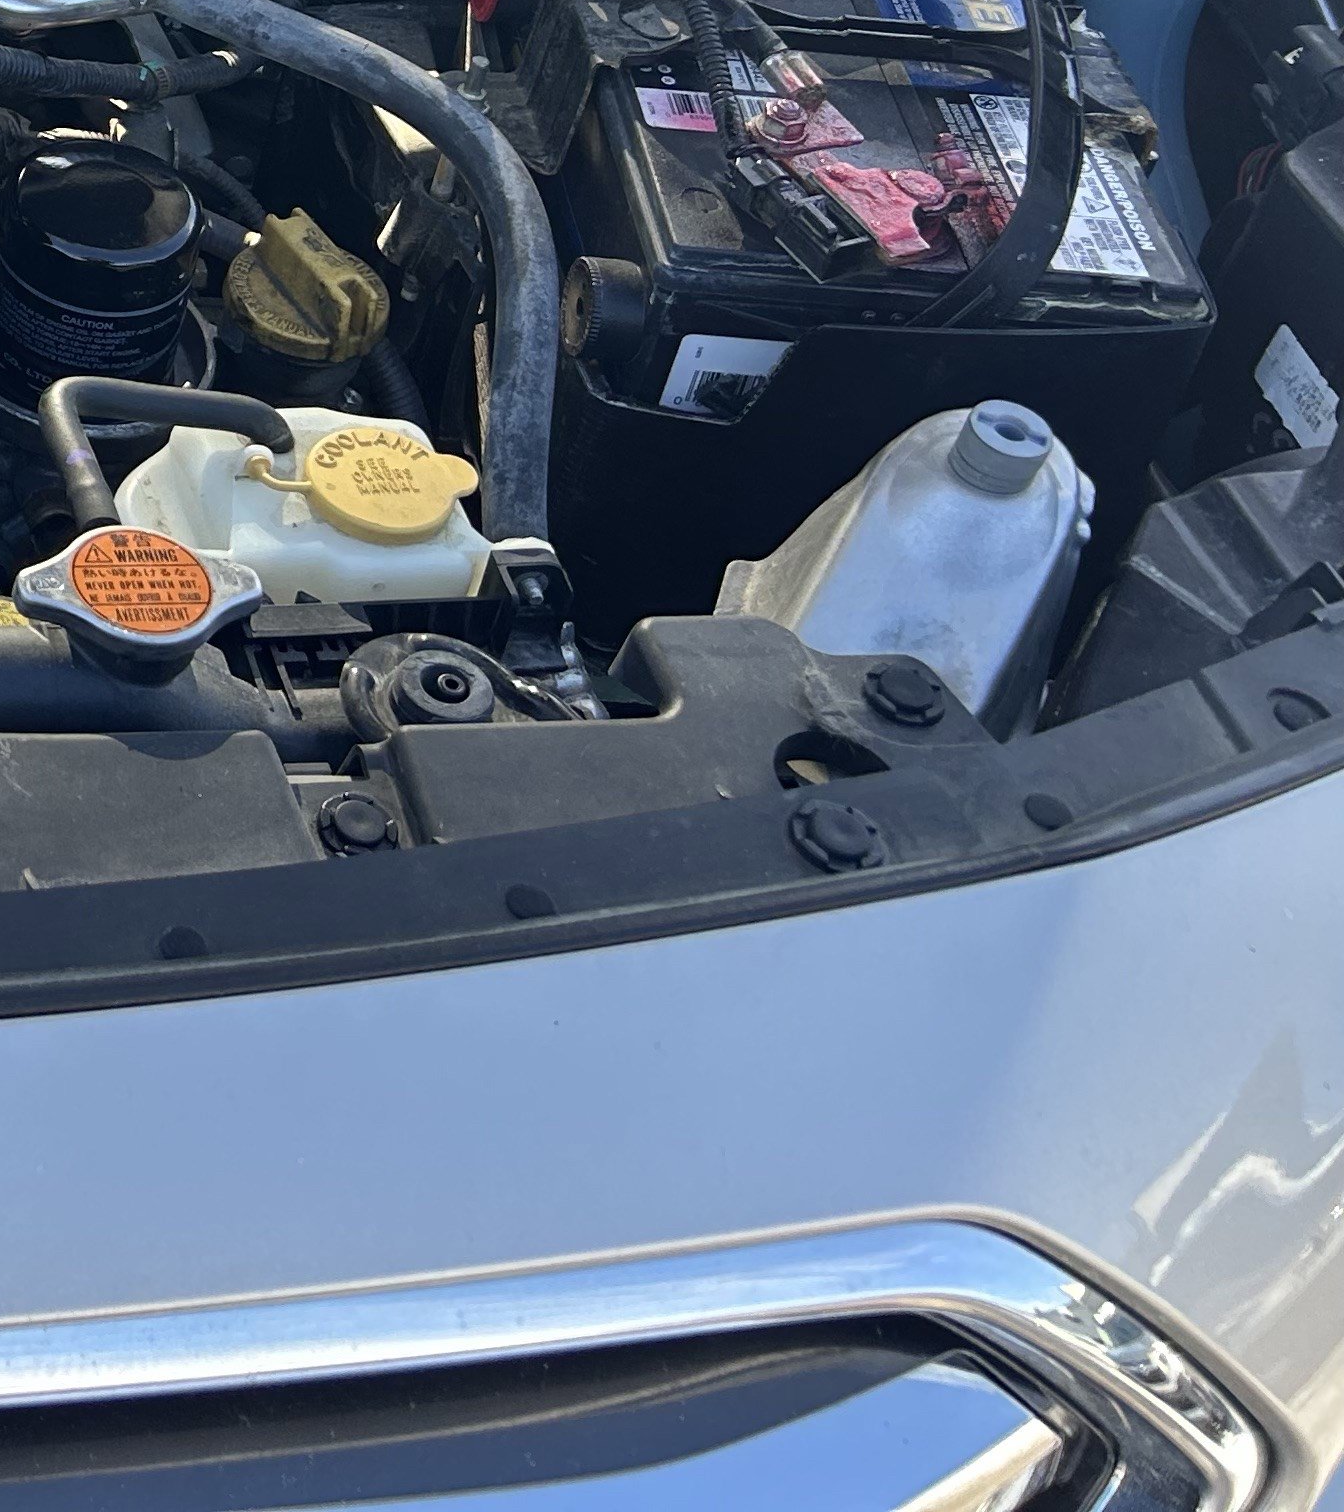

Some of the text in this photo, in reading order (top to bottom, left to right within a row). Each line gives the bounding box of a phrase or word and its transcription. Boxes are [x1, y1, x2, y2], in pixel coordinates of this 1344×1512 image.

[61, 314, 114, 331] CAUTION
[314, 431, 430, 469] COOLANT
[355, 456, 386, 471] SEE
[356, 480, 421, 496] MANUAL
[113, 548, 178, 563] WARNING
[85, 581, 115, 590] NEVER
[119, 581, 144, 590] OPEN
[148, 579, 175, 589] WHEN
[115, 606, 191, 622] AVERTISSMENT
